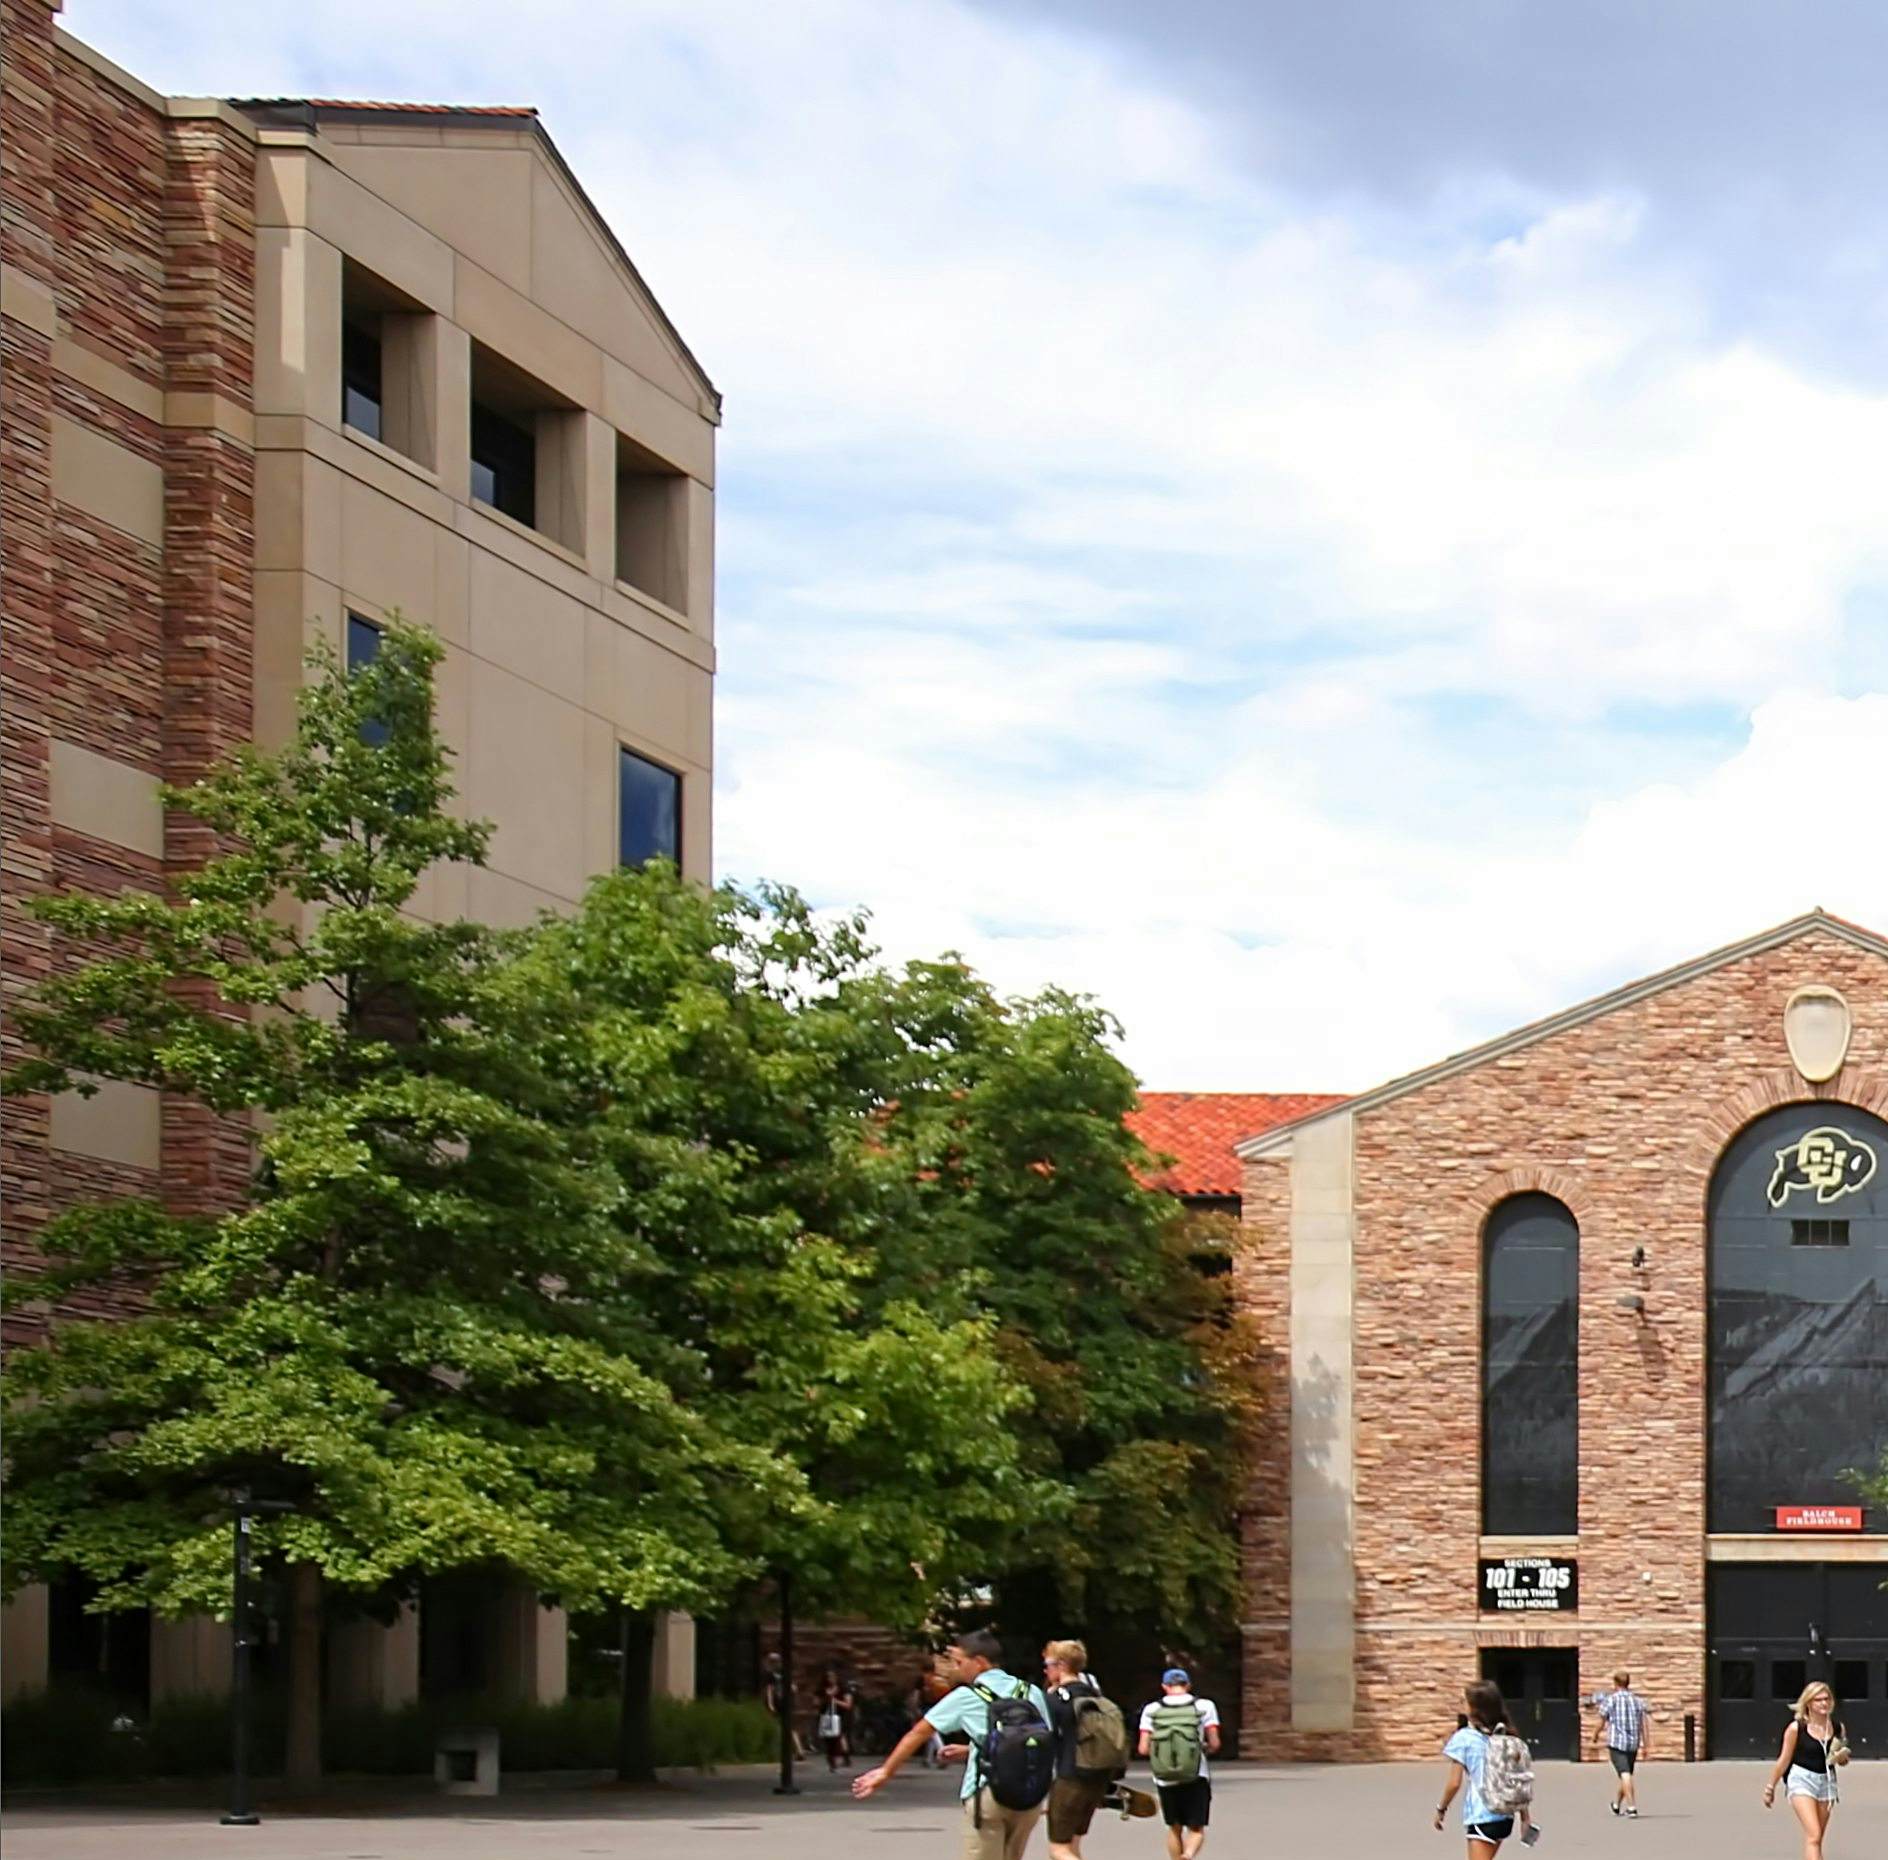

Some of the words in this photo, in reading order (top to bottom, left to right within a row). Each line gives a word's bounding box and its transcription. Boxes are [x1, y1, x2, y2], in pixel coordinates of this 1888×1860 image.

[1504, 1559, 1551, 1568] SECTIONS
[1486, 1567, 1515, 1589] 101
[1538, 1567, 1570, 1589] 105
[1497, 1588, 1529, 1597] ENTER
[1530, 1588, 1556, 1597] THRU
[1497, 1599, 1525, 1609] FIELD
[1526, 1599, 1558, 1609] HOUSE
